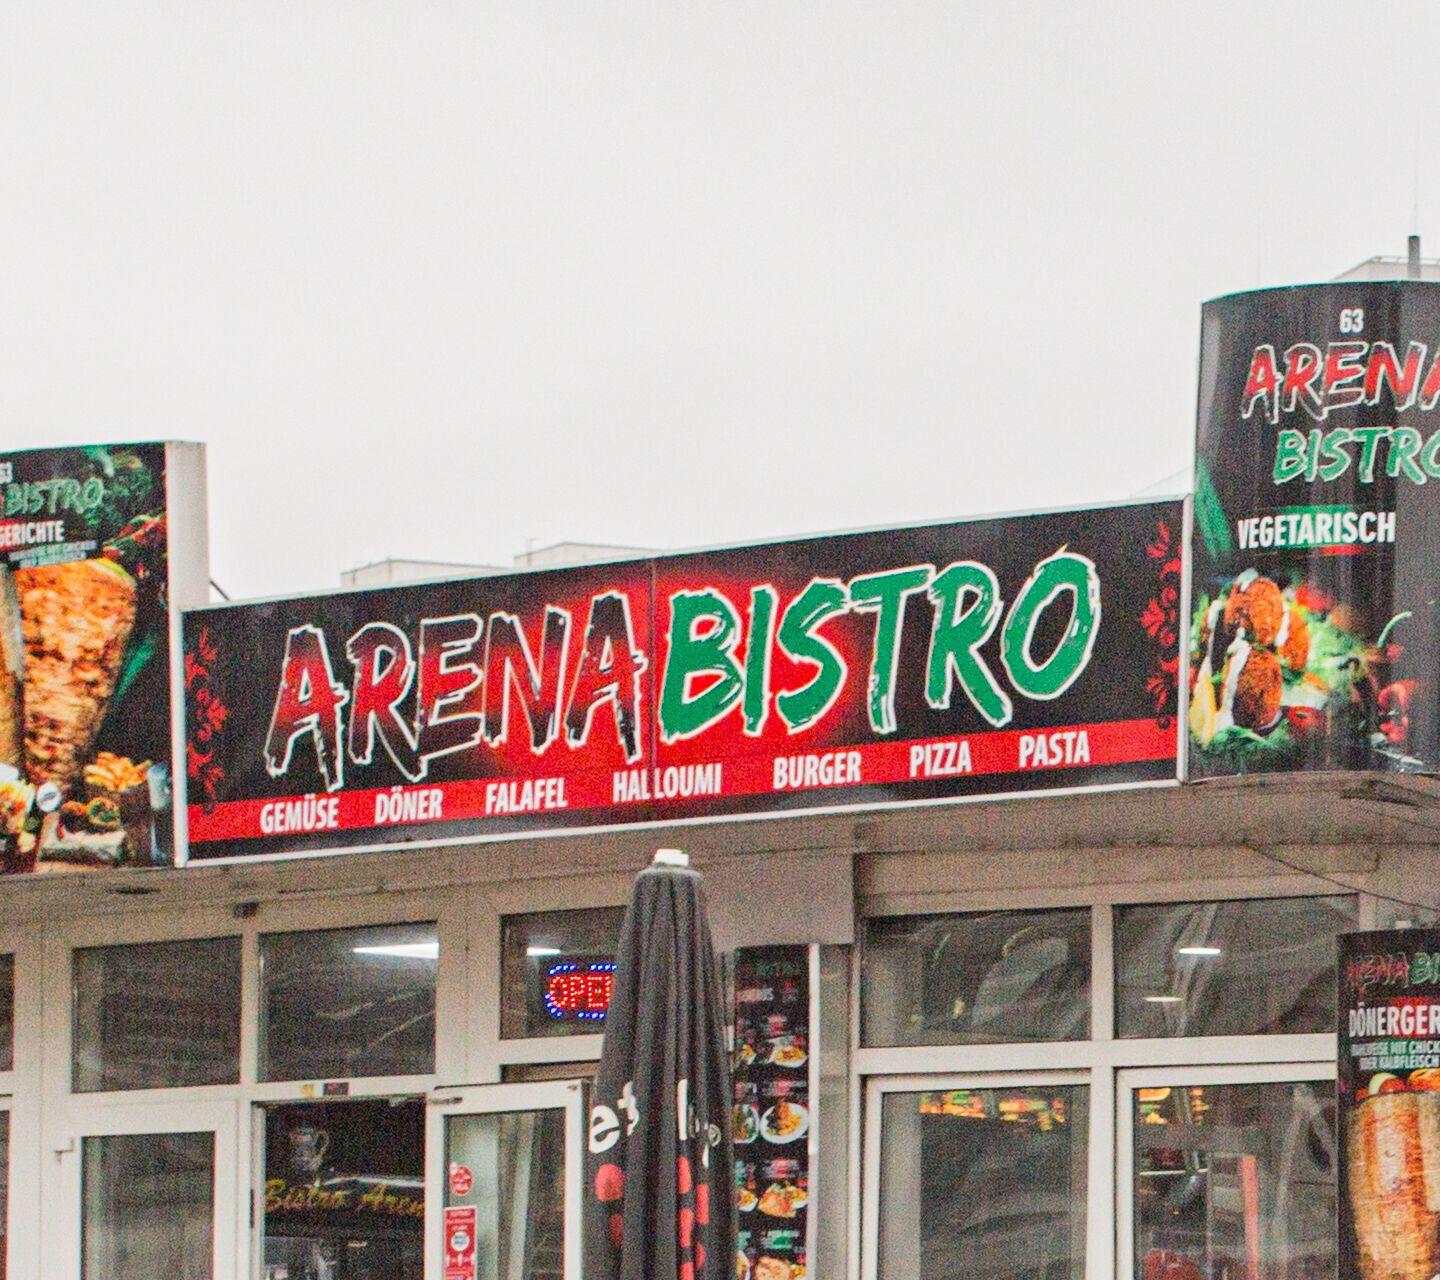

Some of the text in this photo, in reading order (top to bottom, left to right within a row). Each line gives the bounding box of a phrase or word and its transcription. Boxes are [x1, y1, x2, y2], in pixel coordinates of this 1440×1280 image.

[1340, 308, 1364, 333] 63
[5, 477, 104, 516] BISTRO
[1238, 511, 1396, 550] VEGETARISCH
[263, 544, 1101, 792] ARENA BISTRO
[260, 731, 1091, 836] GEMÜSE DÖNER FALAFEL HALLOUMI BURGER PIZZA PASTA
[550, 972, 614, 1011] OPE
